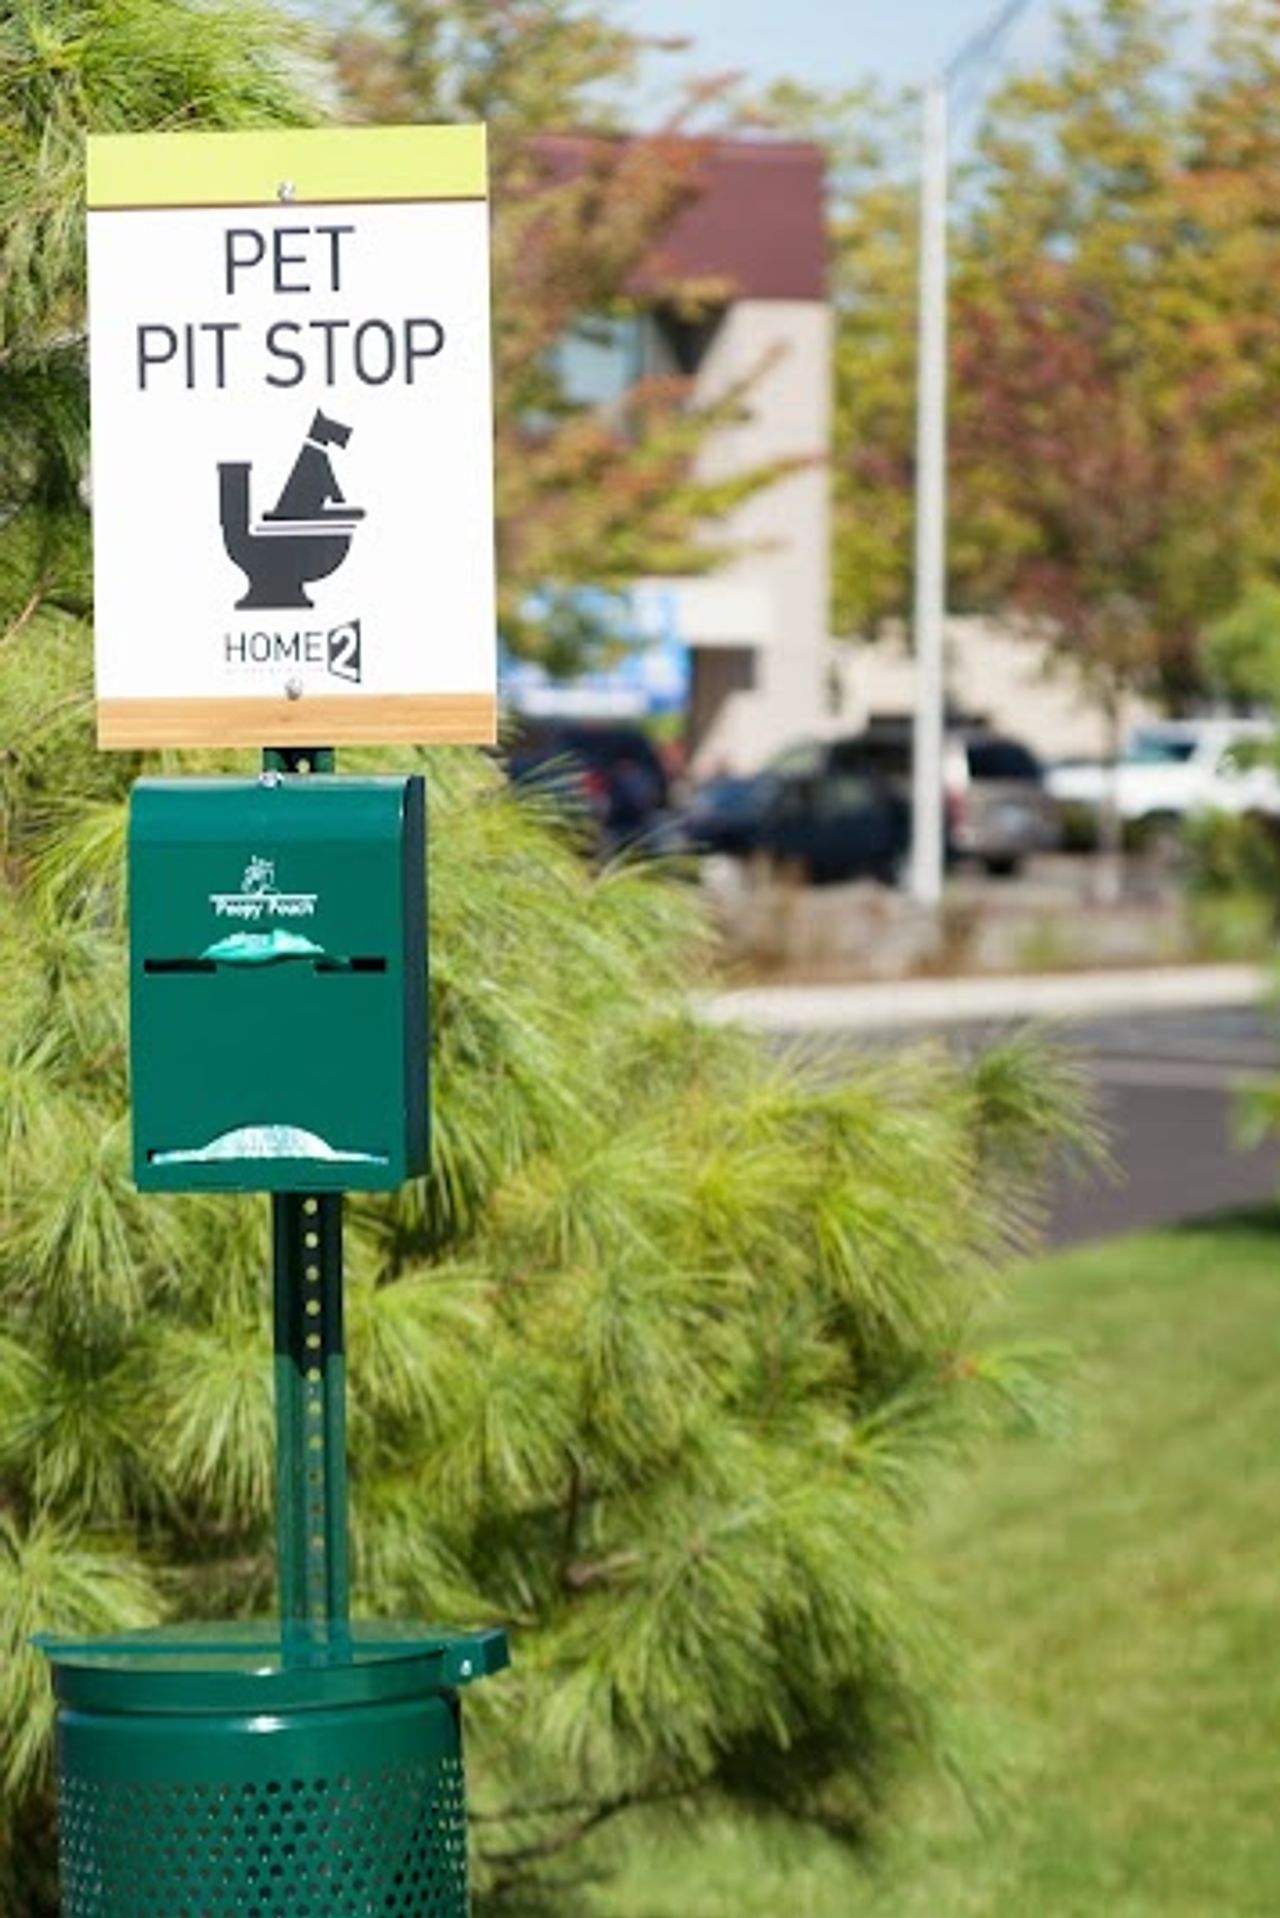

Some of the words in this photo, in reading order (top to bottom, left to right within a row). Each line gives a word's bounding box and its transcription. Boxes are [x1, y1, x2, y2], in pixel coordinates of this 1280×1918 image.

[225, 225, 355, 295] PET
[136, 322, 240, 390] PIT
[265, 318, 445, 388] STOP
